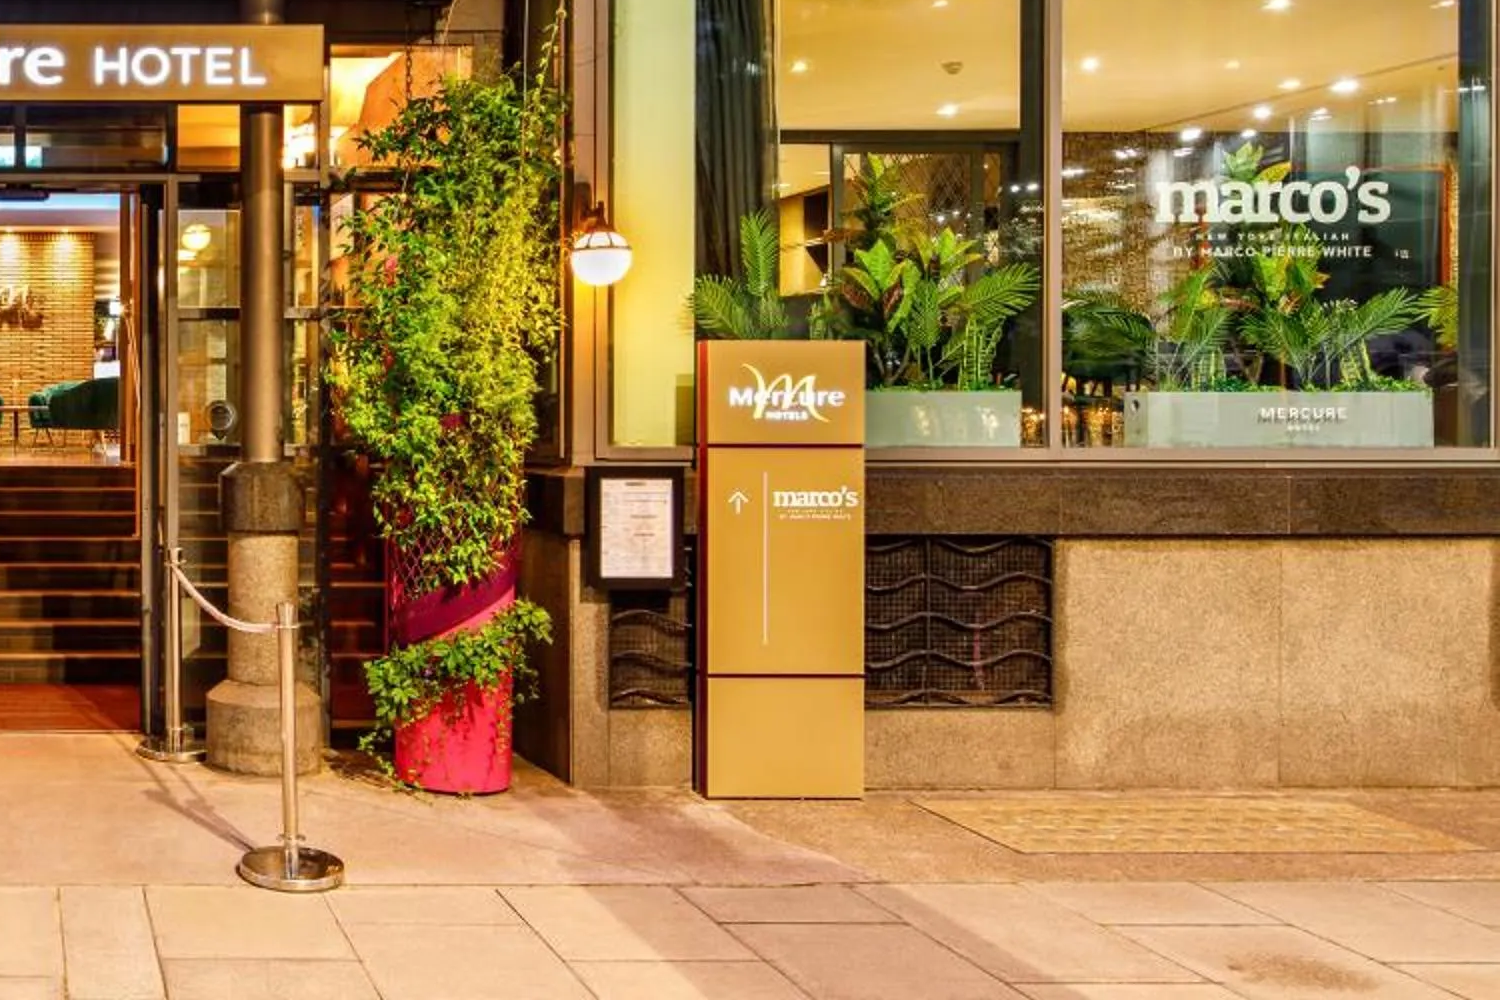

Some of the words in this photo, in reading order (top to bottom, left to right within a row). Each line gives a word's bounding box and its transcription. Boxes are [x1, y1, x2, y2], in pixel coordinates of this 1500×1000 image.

[95, 47, 267, 85] HOTEL
[1154, 165, 1392, 224] marco's
[1322, 245, 1373, 258] WHITE
[1260, 406, 1349, 419] MERCURE
[772, 485, 860, 508] marco's
